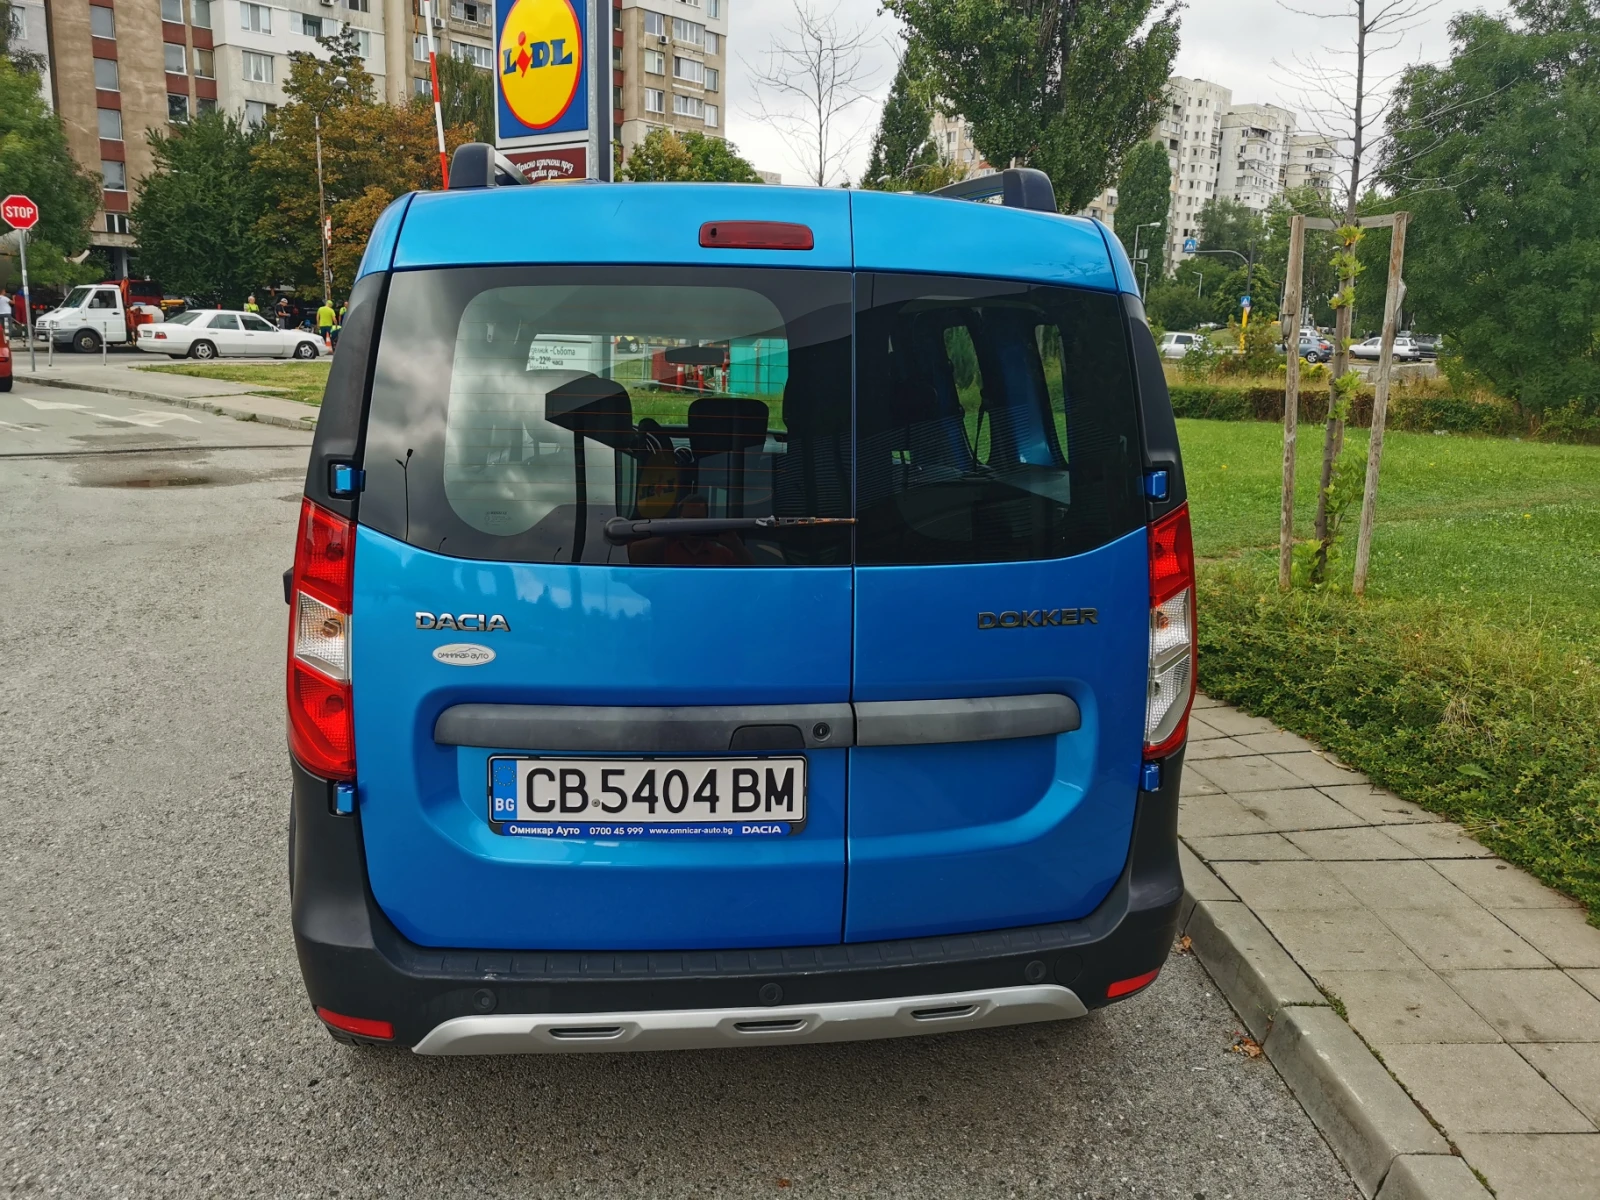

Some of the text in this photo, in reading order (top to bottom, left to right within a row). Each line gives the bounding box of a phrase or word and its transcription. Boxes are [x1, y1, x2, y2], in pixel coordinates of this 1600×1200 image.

[5, 205, 34, 218] STOP
[415, 611, 511, 632] DACIA
[978, 607, 1098, 629] DOKKER
[495, 797, 515, 812] BG
[509, 825, 782, 837] Омникар Ауто 0700 45 999 www.omnicar-auto.bg DACIA
